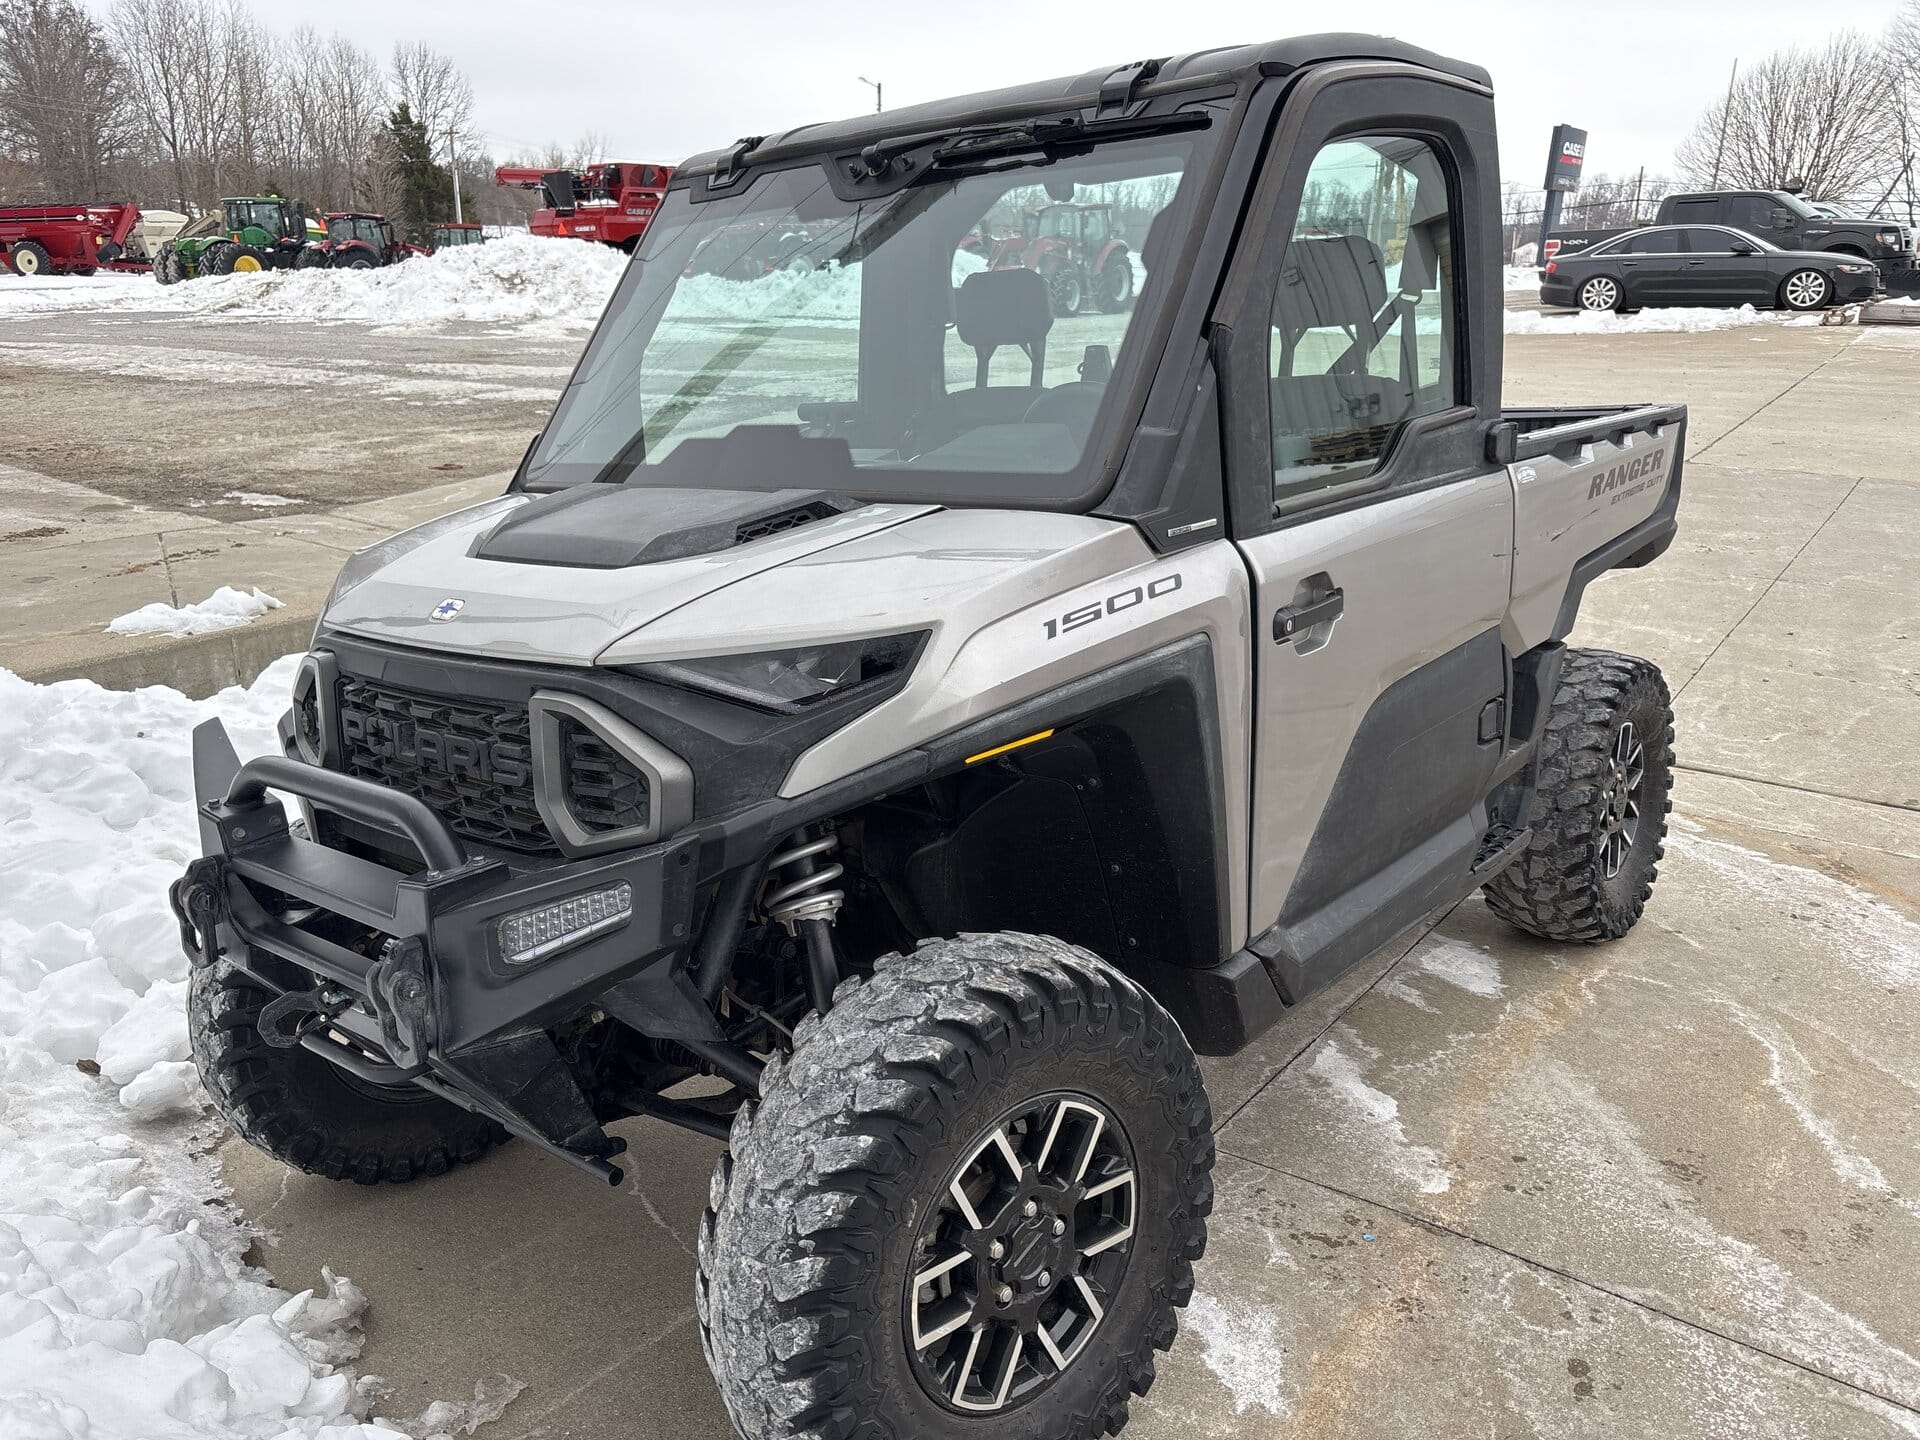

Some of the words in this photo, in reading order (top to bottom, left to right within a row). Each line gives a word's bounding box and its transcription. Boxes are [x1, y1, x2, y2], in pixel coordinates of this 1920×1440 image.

[1563, 141, 1582, 156] CASE
[1588, 448, 1664, 500] RANGER
[1611, 483, 1645, 505] EXTREME
[1646, 474, 1664, 489] DUTY
[1043, 573, 1182, 640] 1500
[342, 708, 529, 787] POLARIS
